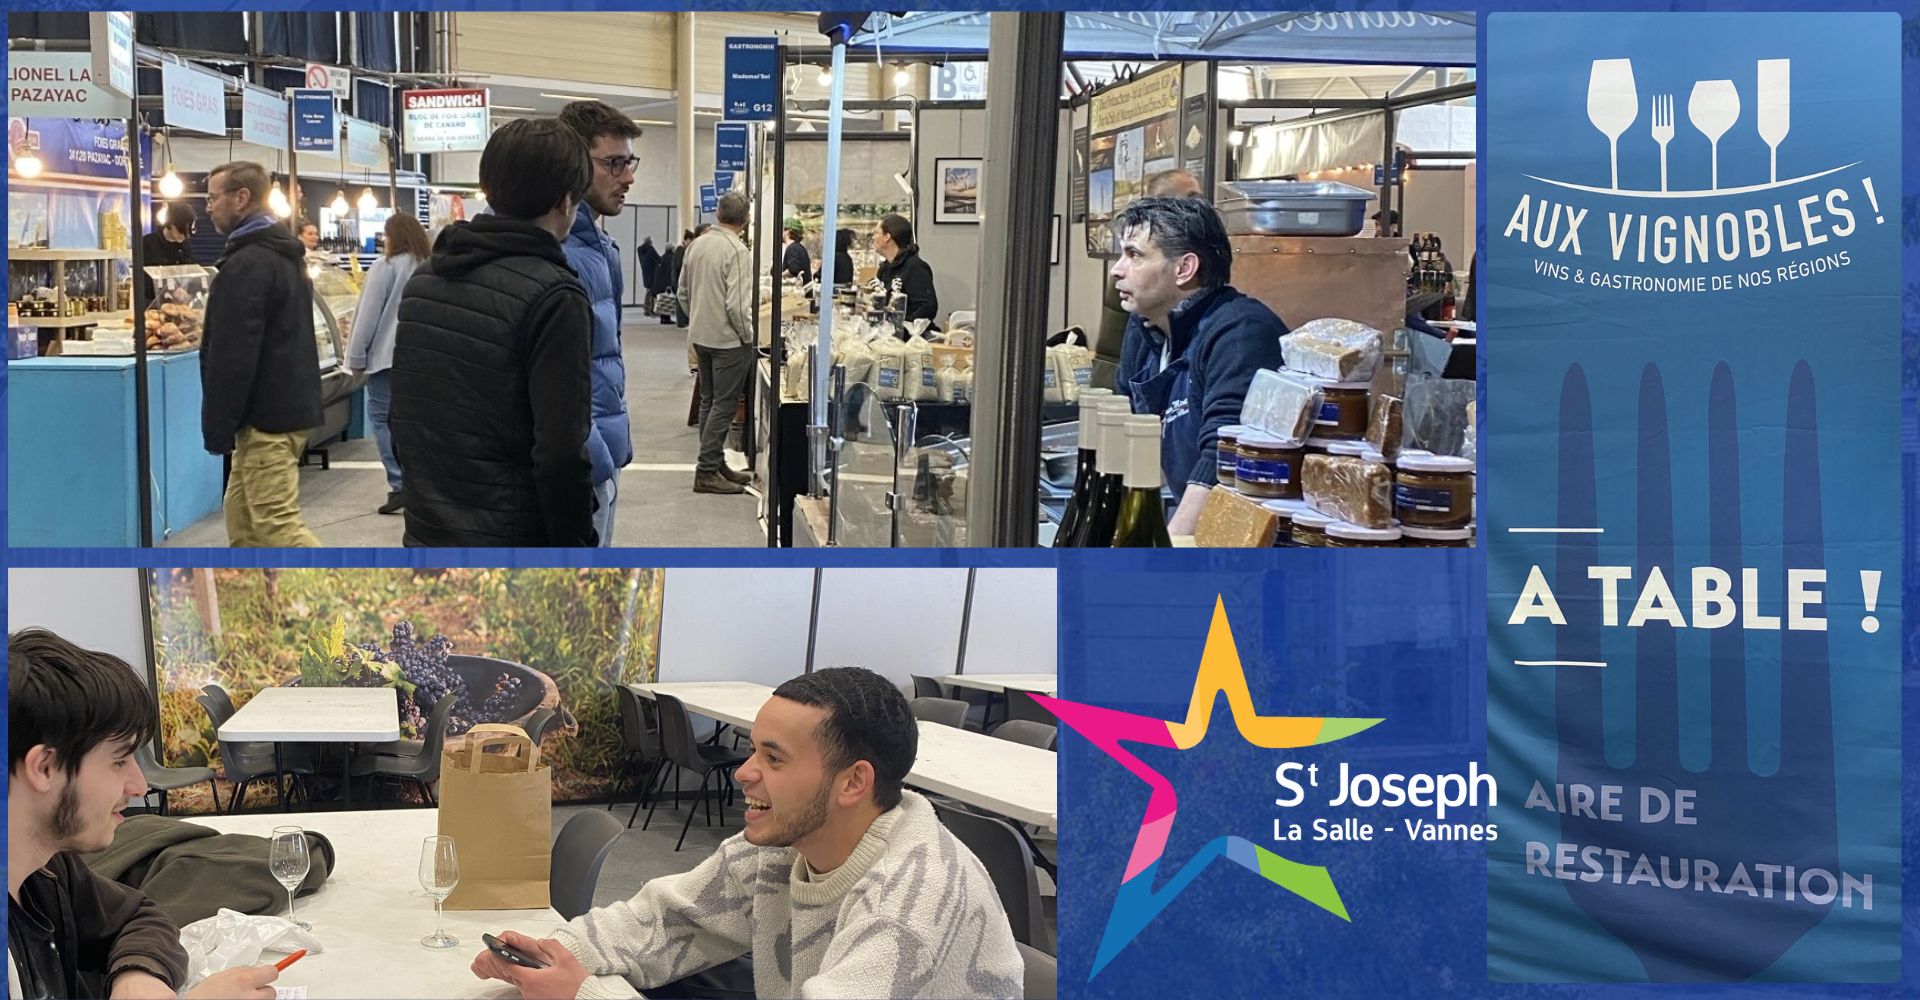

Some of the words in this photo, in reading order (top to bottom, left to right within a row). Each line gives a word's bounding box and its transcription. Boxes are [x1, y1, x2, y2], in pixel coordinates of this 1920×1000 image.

[11, 87, 88, 102] PAZAYAC
[937, 63, 957, 98] B
[195, 91, 218, 115] GRAS
[408, 93, 483, 108] SANDWICH
[408, 112, 429, 121] BLOC
[460, 111, 482, 119] GRAS
[753, 104, 773, 112] G12
[1503, 193, 1589, 256] AUX
[1608, 188, 1857, 264] VIGNOBLES
[1861, 176, 1885, 226] !
[1534, 259, 1569, 281] VINS
[1574, 269, 1585, 285] &
[1590, 271, 1705, 293] GASTRONOMIE
[1712, 275, 1734, 292] DE
[1737, 269, 1772, 289] NOS
[1777, 250, 1852, 282] RÉGIONS
[1507, 564, 1568, 625] A
[1587, 565, 1828, 631] TABLE
[1859, 569, 1883, 634] !
[1524, 779, 1623, 823] AIRE
[1639, 785, 1698, 825] DE
[1526, 840, 1874, 911] RESTAURATION
